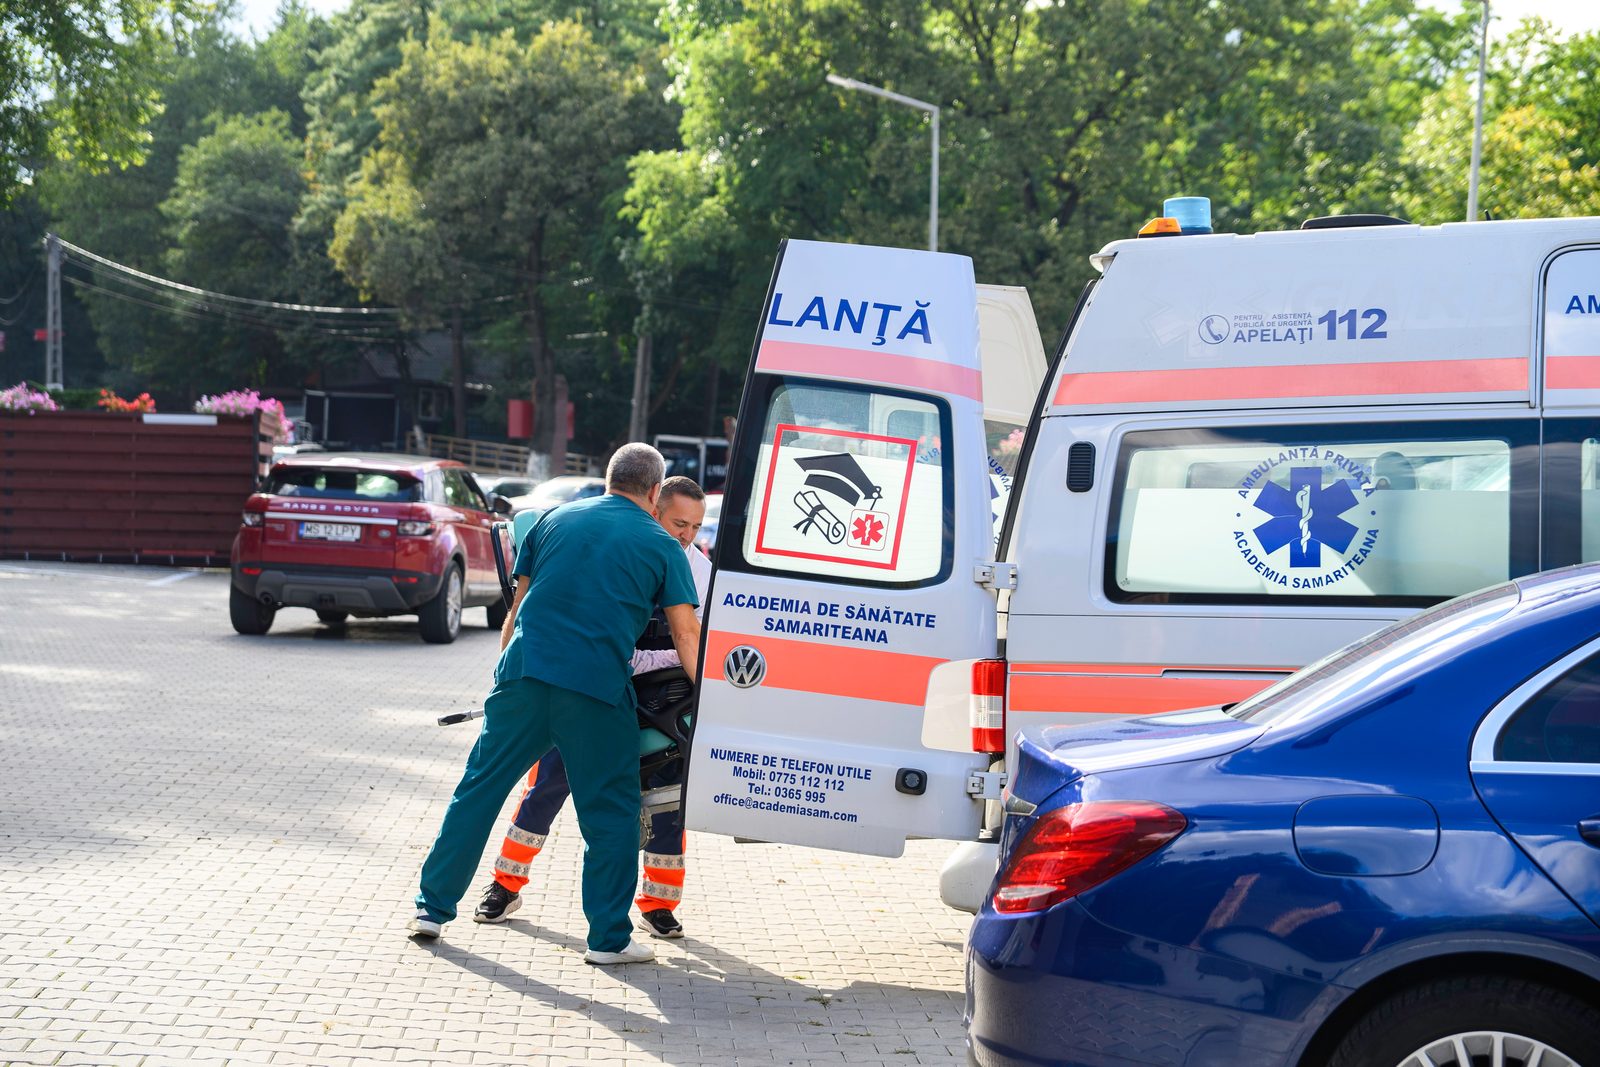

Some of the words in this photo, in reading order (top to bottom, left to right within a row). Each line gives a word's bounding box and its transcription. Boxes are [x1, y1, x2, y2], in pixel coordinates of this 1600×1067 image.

[1318, 308, 1388, 341] 112
[282, 502, 327, 511] RANGE
[333, 505, 379, 513] ROVER
[305, 523, 320, 534] MS
[1233, 529, 1288, 587] ACADEMIA
[1292, 528, 1379, 589] SAMARITEANA
[723, 592, 811, 615] ACADEMIA
[817, 602, 840, 618] DE
[844, 603, 937, 629] SĂNĂTATE
[763, 617, 889, 644] SAMARITEANA
[710, 748, 759, 765] NUMERE
[762, 755, 778, 768] DE
[781, 757, 833, 776] TELEFON
[837, 765, 872, 781] UTILE
[732, 765, 766, 781] Mobil:
[769, 771, 797, 785] 0775
[800, 775, 821, 788] 112
[824, 778, 845, 792] 112
[748, 782, 771, 796] Tel.:
[774, 786, 802, 801] 0365
[805, 790, 826, 804] 995
[713, 793, 858, 823] office@academiasam.com
